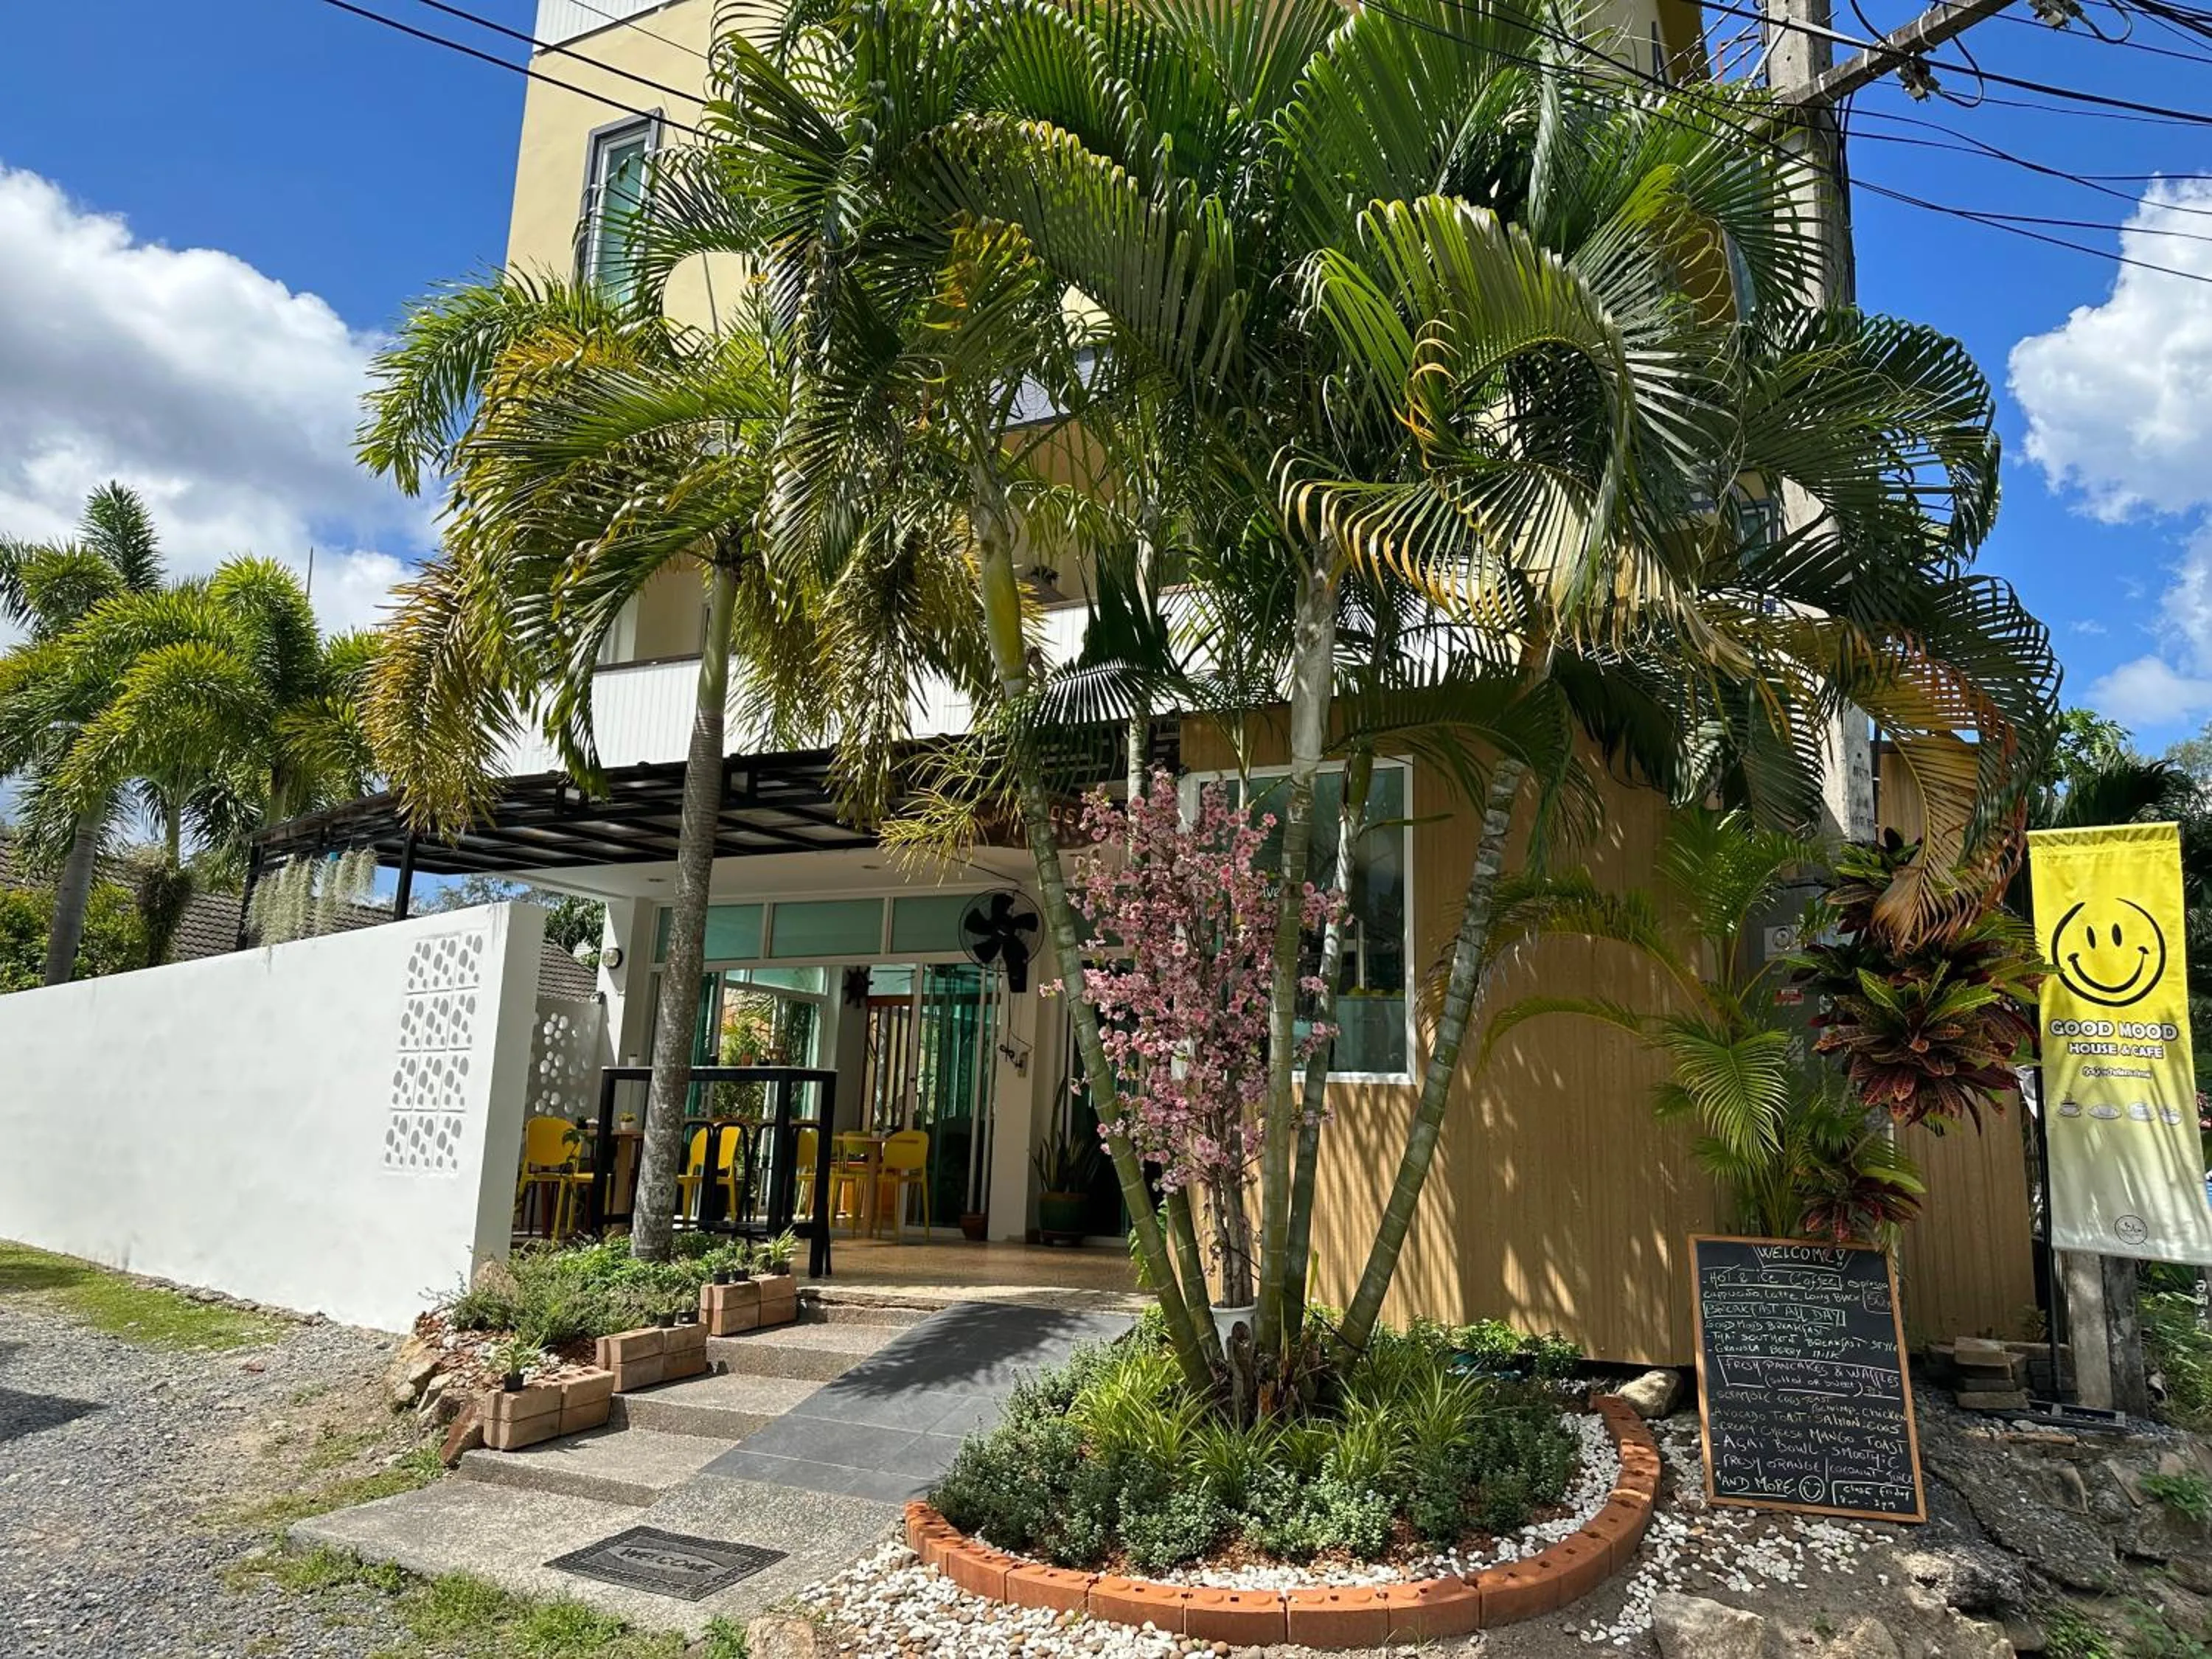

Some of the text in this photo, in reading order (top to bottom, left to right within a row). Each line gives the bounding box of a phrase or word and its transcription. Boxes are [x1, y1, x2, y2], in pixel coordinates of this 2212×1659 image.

[2050, 1019, 2179, 1041] GOOD MOOD
[2068, 1042, 2118, 1055] HOUSE
[2121, 1046, 2131, 1056] &
